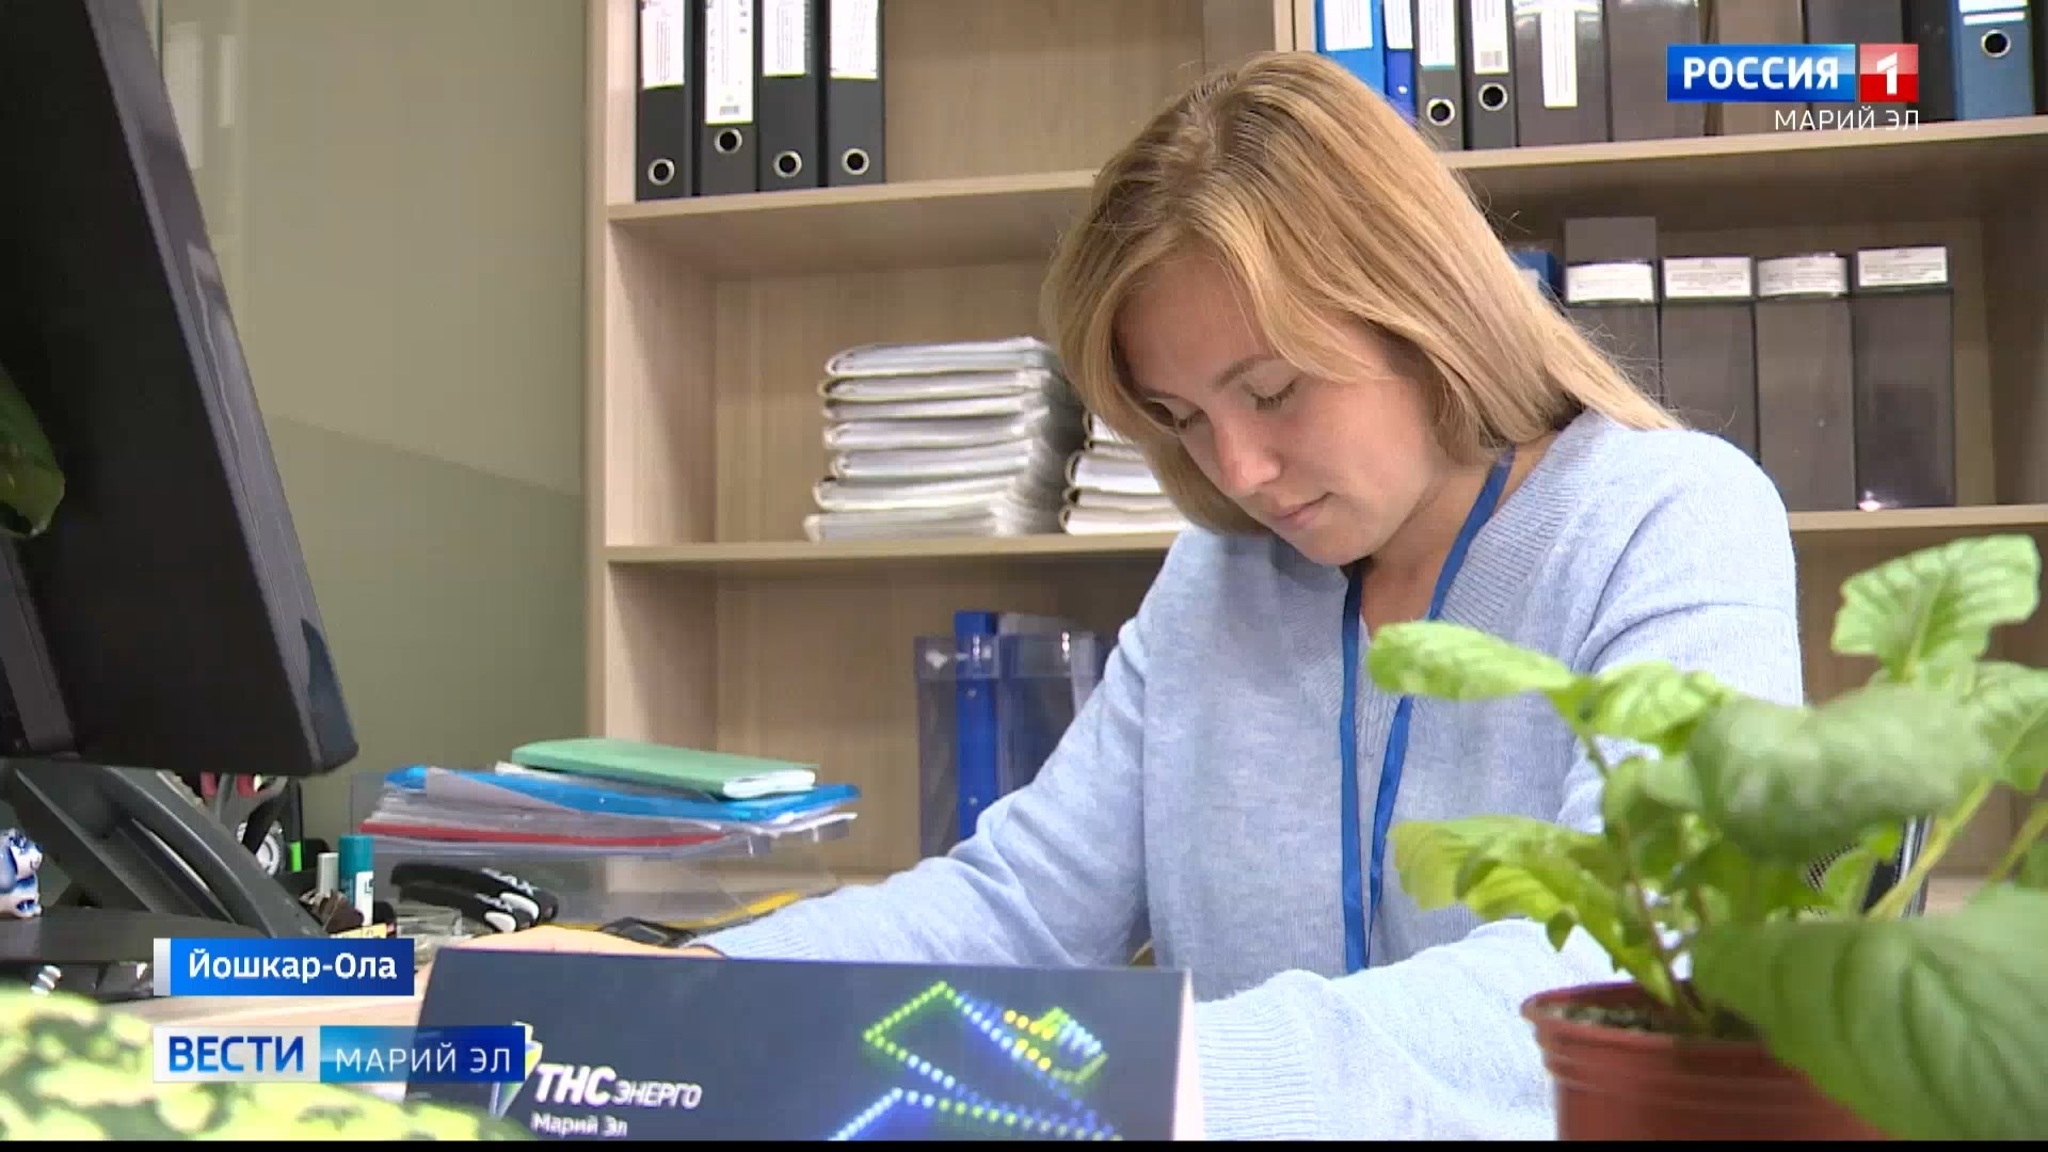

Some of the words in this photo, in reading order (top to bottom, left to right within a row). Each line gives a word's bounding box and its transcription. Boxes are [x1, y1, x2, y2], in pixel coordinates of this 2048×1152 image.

[535, 1063, 617, 1107] ТНС
[531, 1112, 599, 1137] Марий
[602, 1115, 628, 1137] Эл
